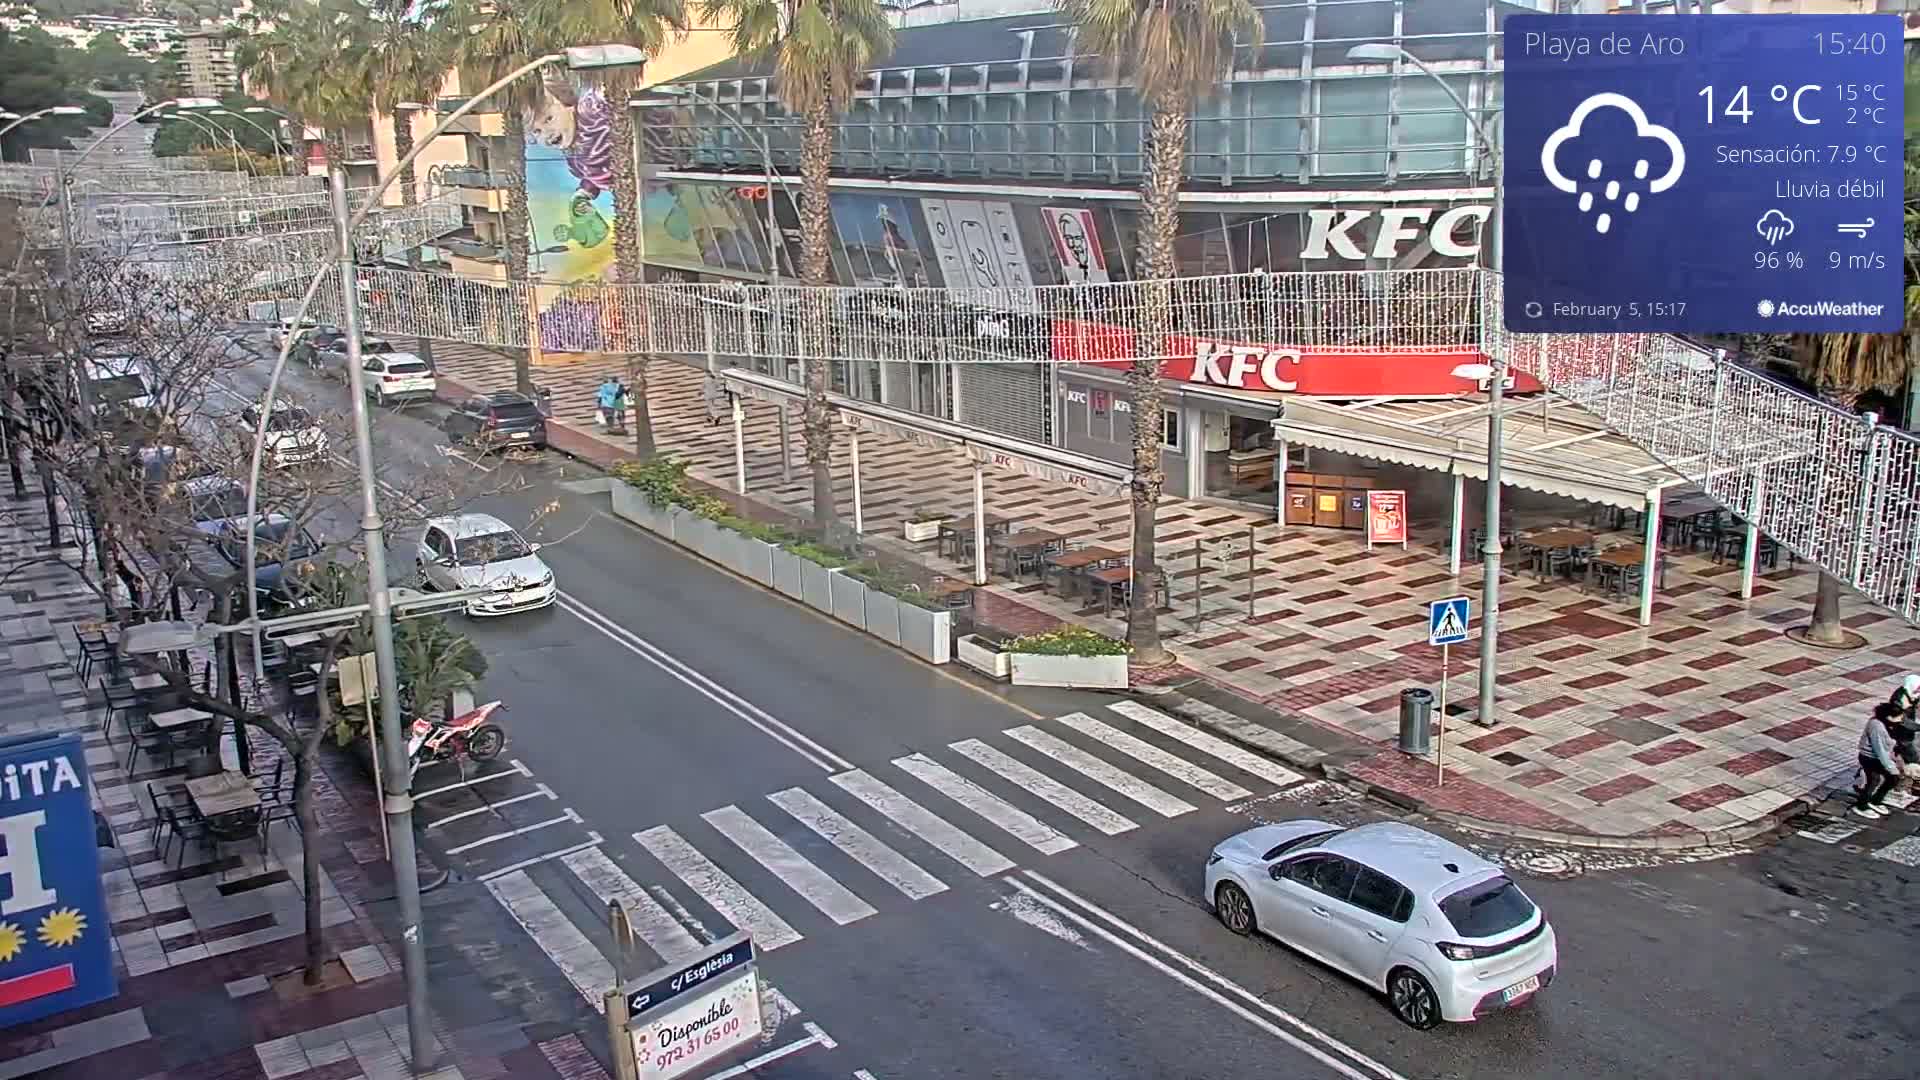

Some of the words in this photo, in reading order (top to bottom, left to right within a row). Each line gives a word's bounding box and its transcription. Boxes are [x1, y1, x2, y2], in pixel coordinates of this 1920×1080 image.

[1300, 205, 1493, 260] KFC
[1189, 341, 1301, 391] KFC
[1067, 390, 1087, 404] KFC
[656, 1046, 684, 1072] 972
[686, 1036, 701, 1055] 31
[704, 1026, 721, 1045] 65
[723, 1017, 739, 1035] 00
[657, 998, 733, 1048] Disponible
